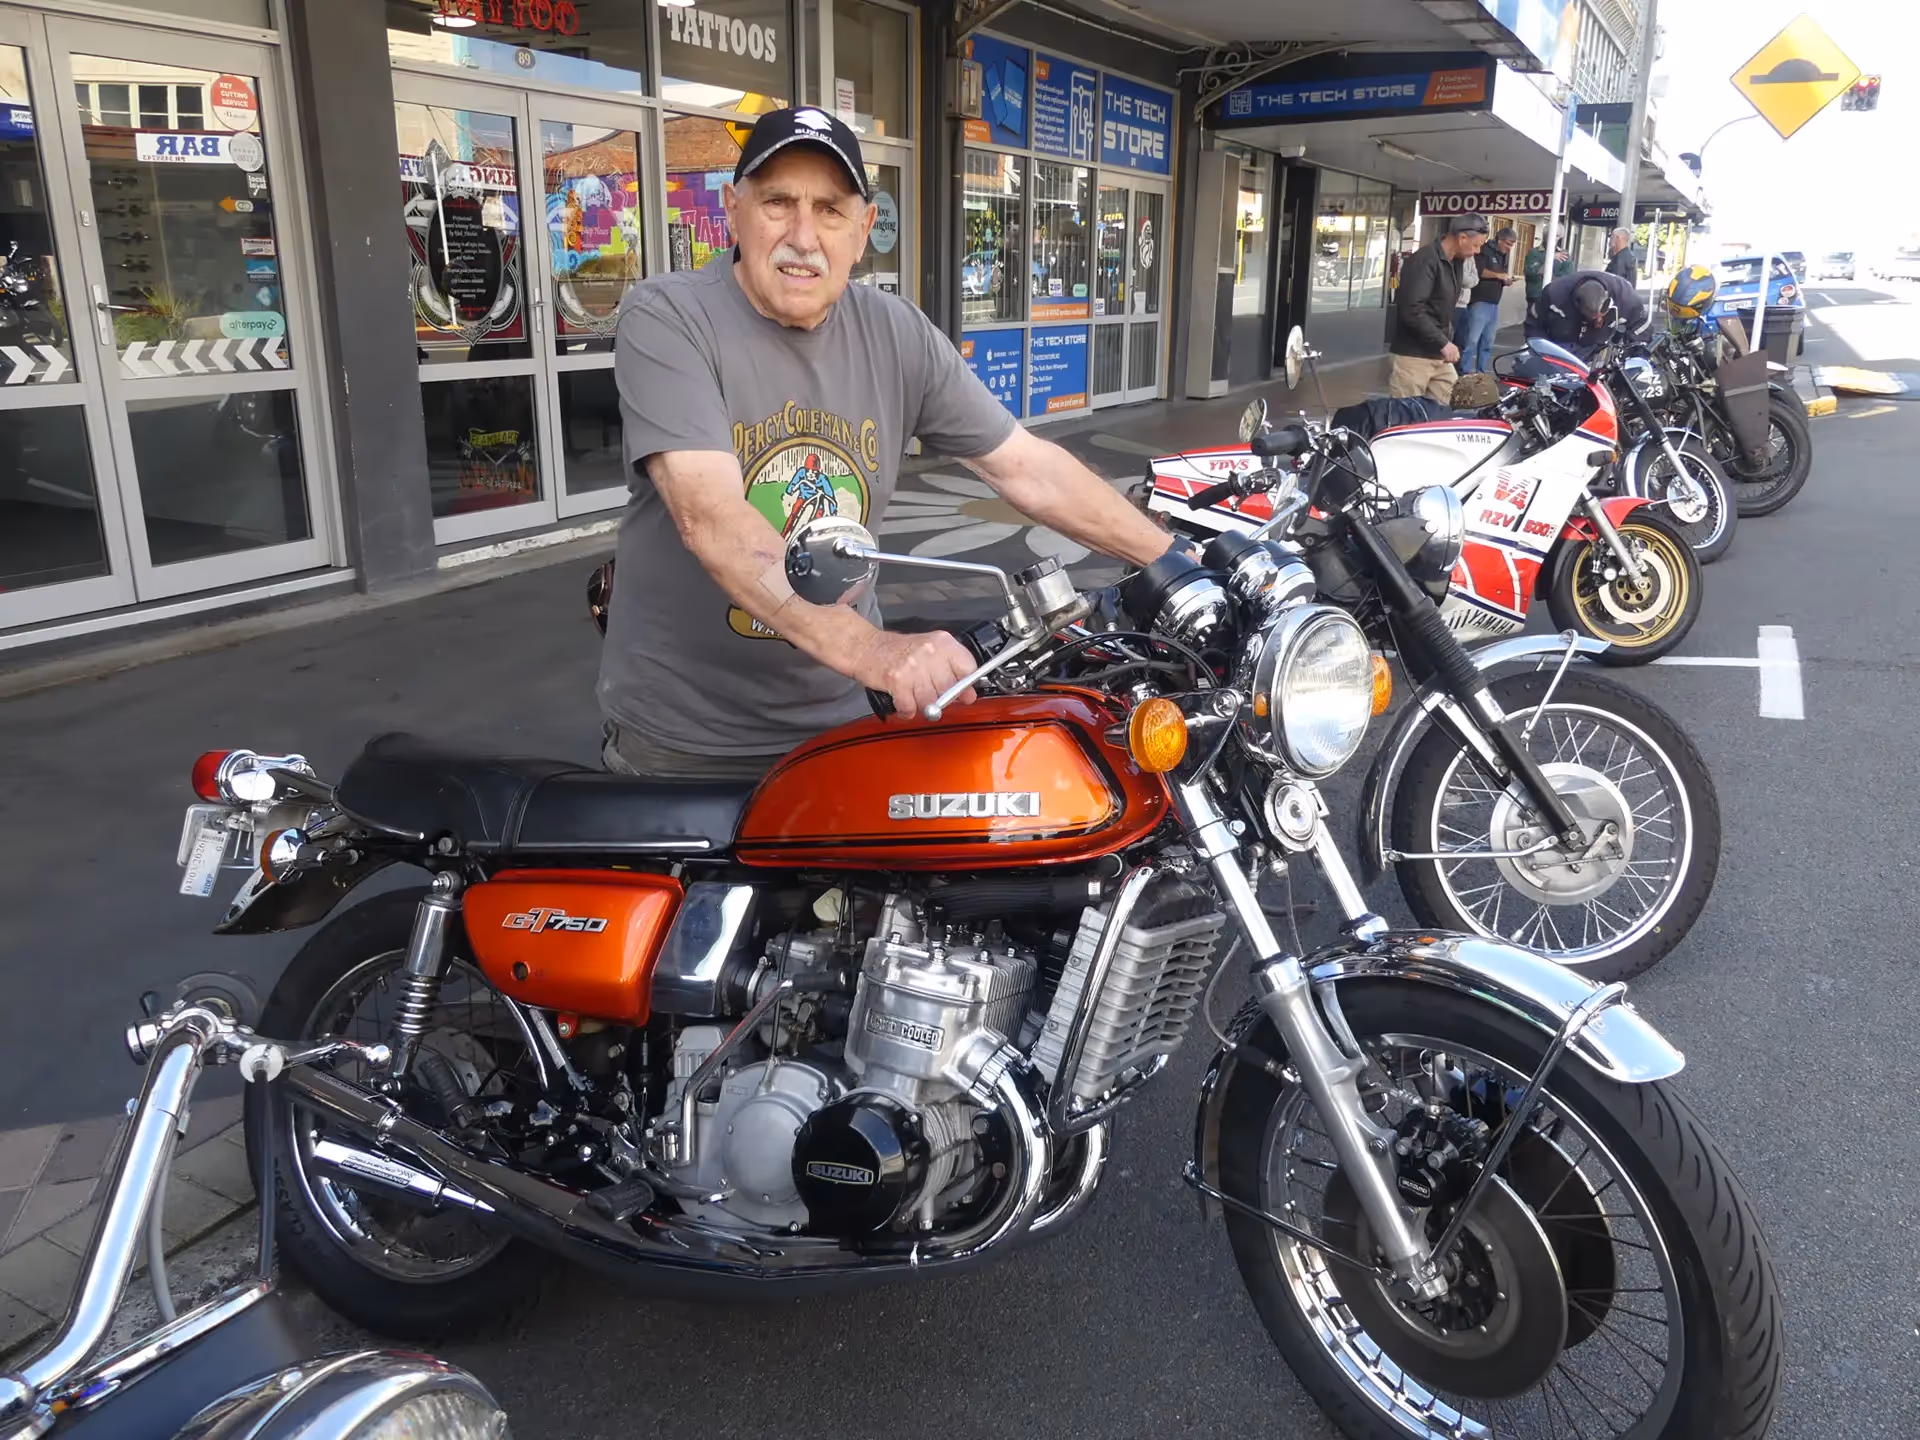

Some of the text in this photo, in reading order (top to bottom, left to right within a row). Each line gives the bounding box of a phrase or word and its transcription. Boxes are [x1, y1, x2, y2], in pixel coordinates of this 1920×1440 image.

[666, 4, 777, 63] TATTOOS
[518, 53, 531, 66] 89
[219, 82, 233, 90] KEY
[220, 90, 249, 100] CUTTING
[221, 99, 249, 108] SERVICE
[1257, 84, 1416, 107] THE TECH STORE
[1105, 90, 1166, 125] THE TECH
[1103, 120, 1165, 160] STORE
[229, 319, 267, 331] afterpay
[1045, 335, 1064, 346] TECH
[1065, 333, 1087, 345] STORE
[732, 414, 784, 466] PERCY
[784, 400, 855, 451] COLEMAN
[1455, 433, 1492, 445] YAMAHA
[1208, 458, 1251, 471] YPVS
[1479, 509, 1516, 527] RZV
[1468, 609, 1516, 635] YAMAHA
[888, 792, 1041, 820] SUZUKI
[501, 907, 609, 933] GT750
[900, 1023, 939, 1045] COOLED
[811, 1164, 870, 1182] SUZUKI
